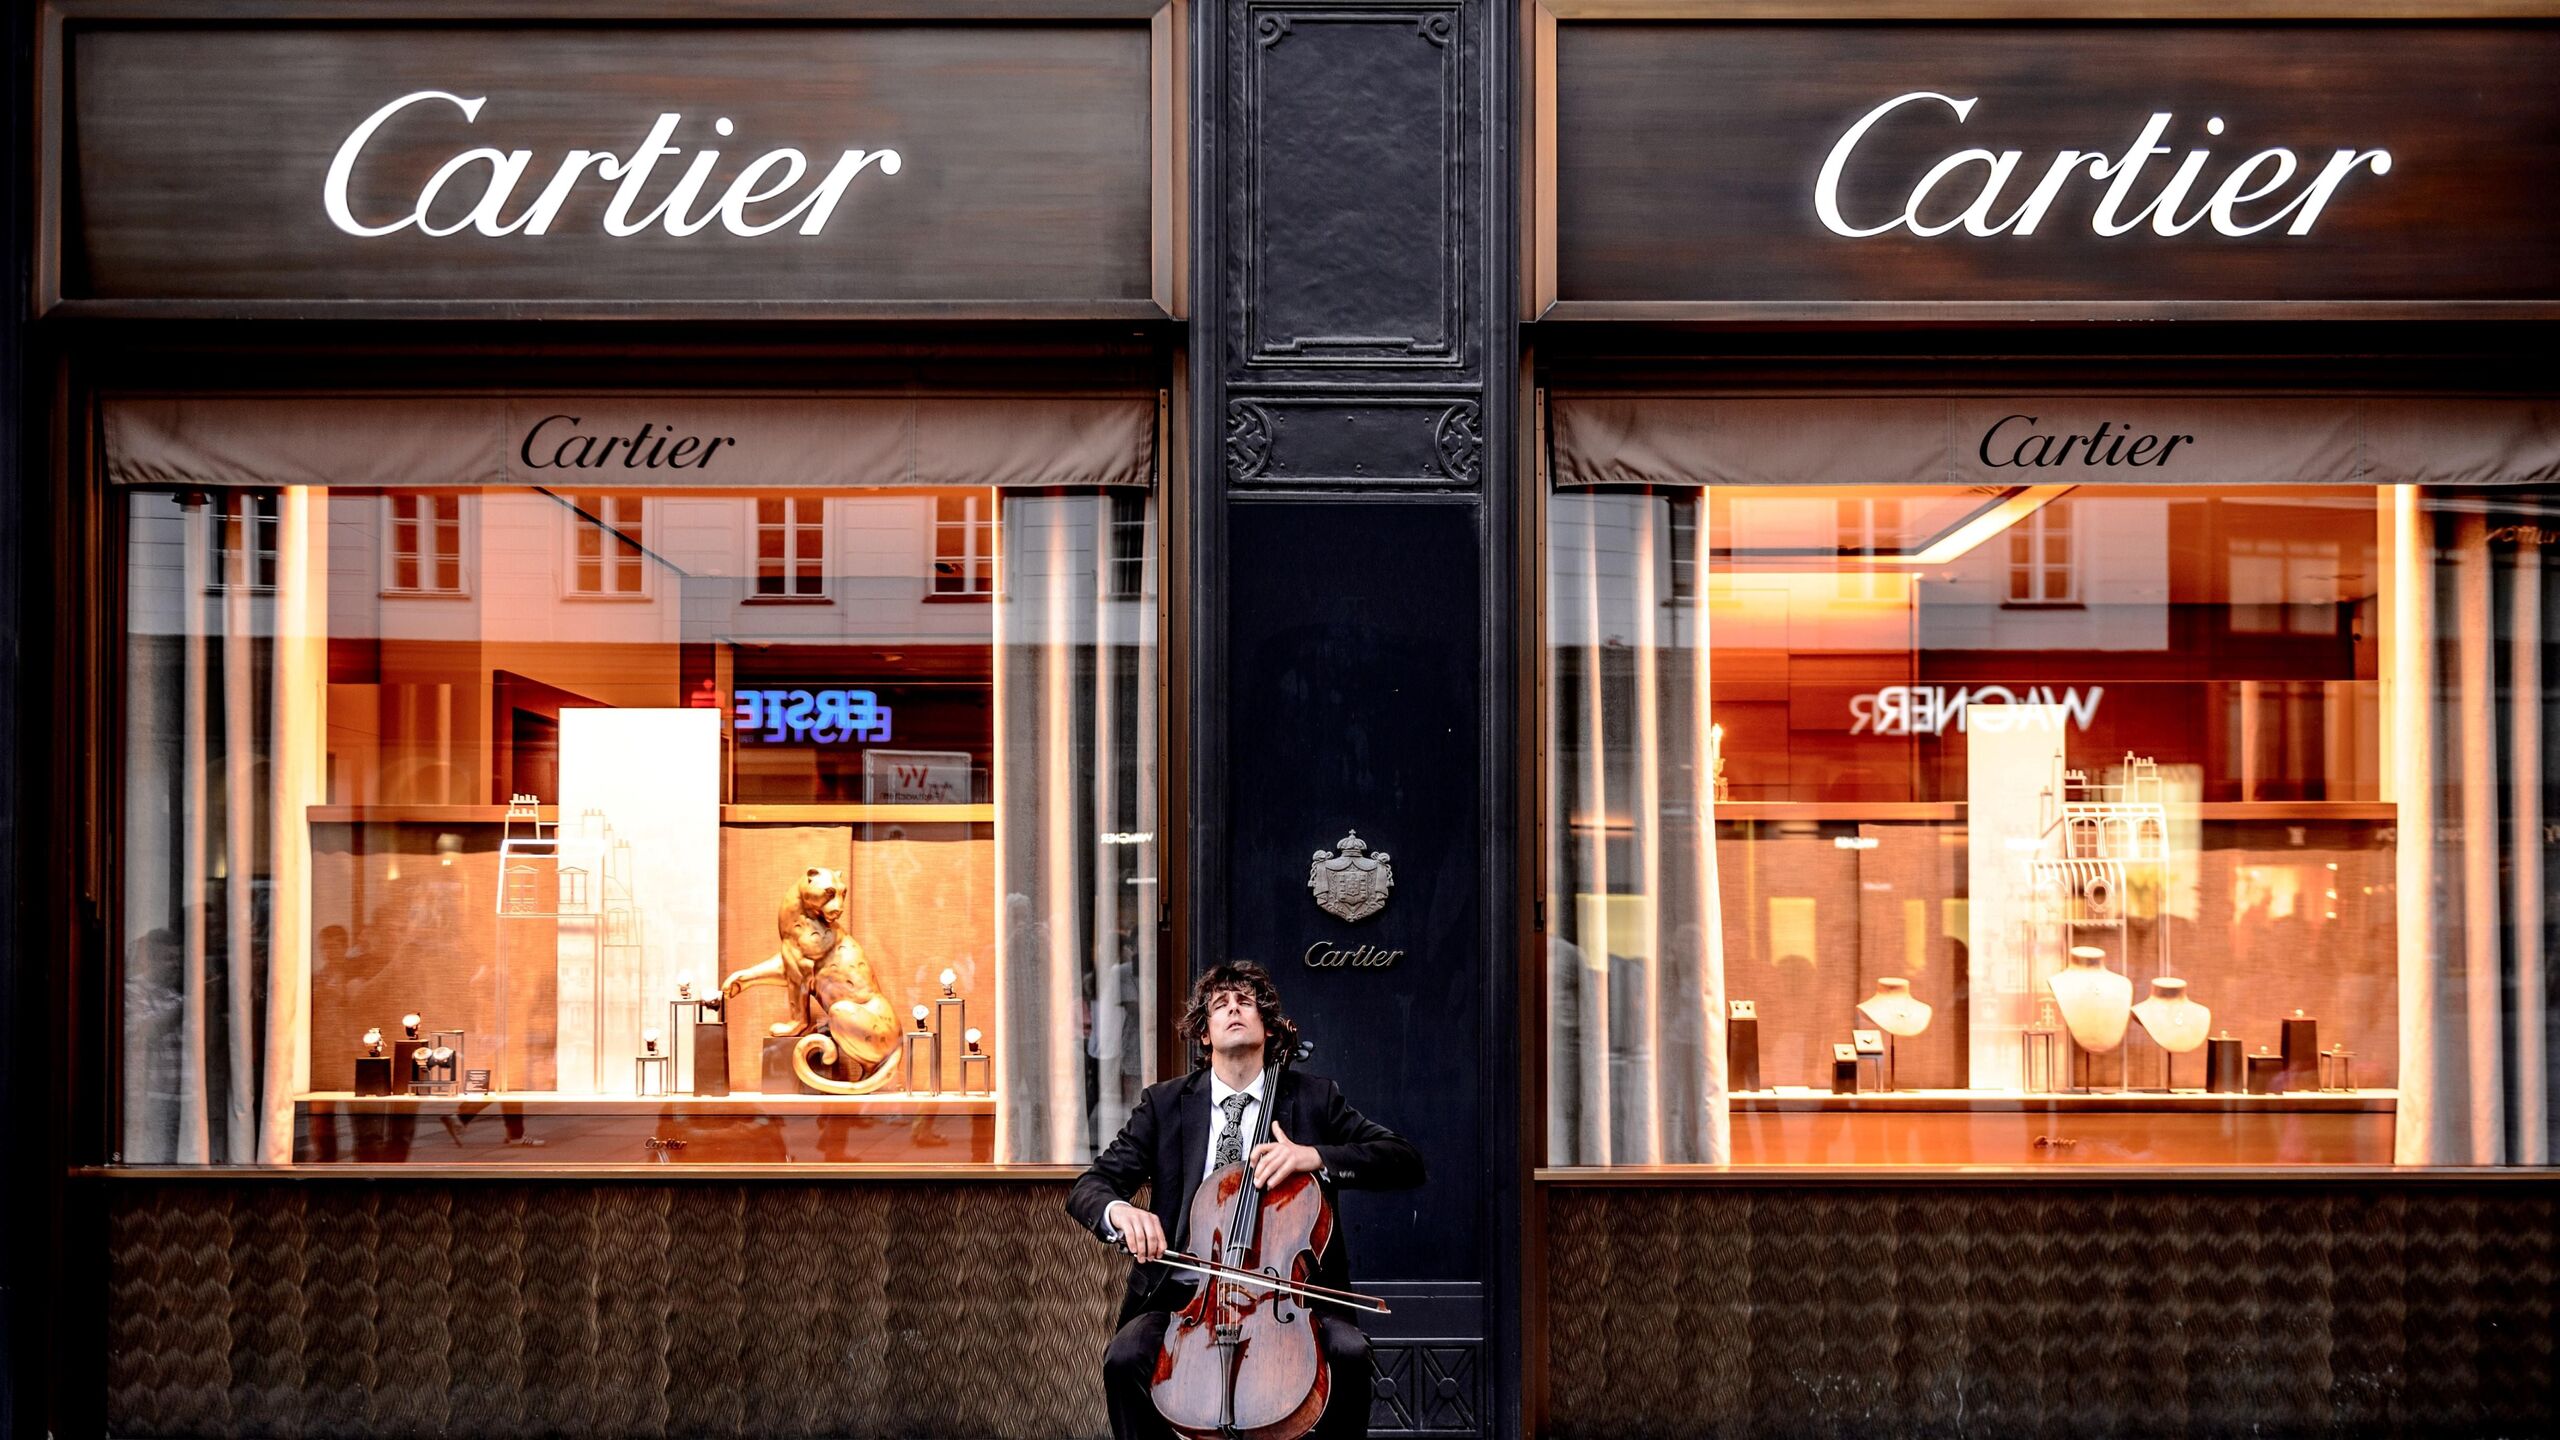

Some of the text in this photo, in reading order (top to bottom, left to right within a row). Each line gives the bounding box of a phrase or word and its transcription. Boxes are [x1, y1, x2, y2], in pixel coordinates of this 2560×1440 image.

[323, 90, 902, 237] Cartier
[1814, 91, 2392, 238] Cartier
[520, 414, 736, 470] Cartier
[1979, 414, 2194, 469] Cartier
[1304, 940, 1404, 968] Cartier
